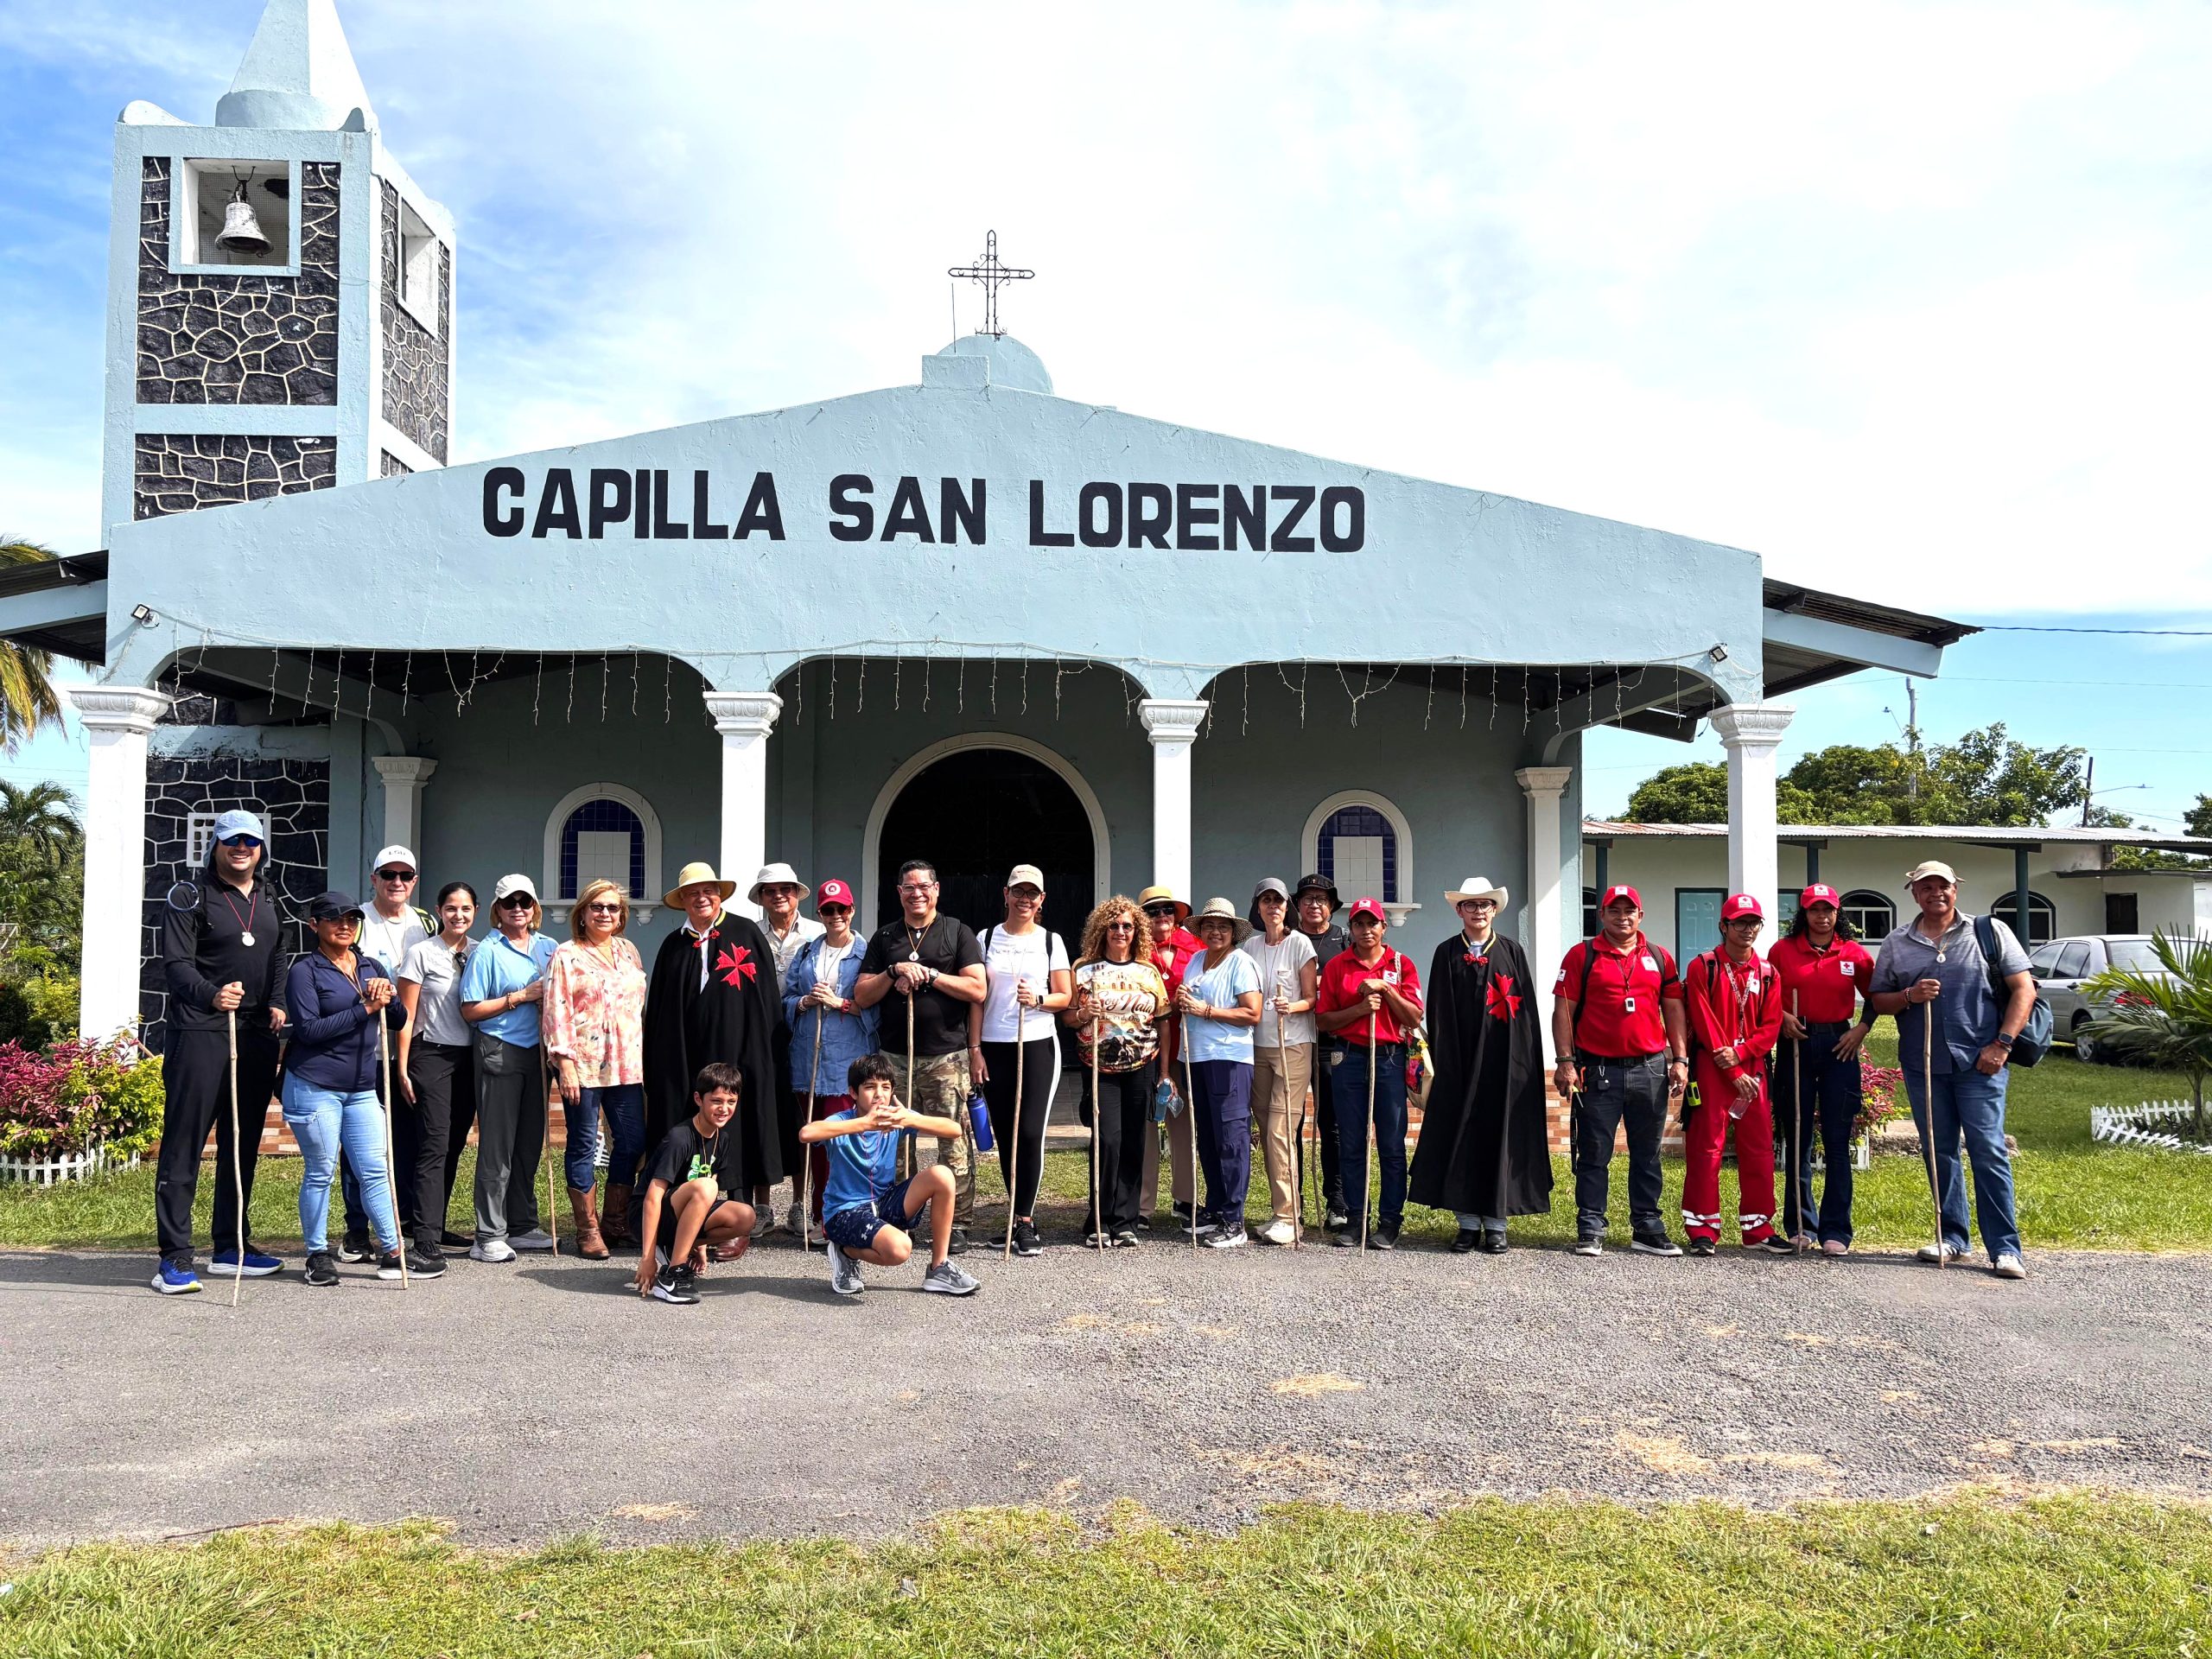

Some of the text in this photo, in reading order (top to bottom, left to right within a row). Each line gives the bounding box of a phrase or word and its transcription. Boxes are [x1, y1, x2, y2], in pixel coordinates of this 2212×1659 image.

[484, 467, 1364, 553] CAPILLA SAN LORENZO
